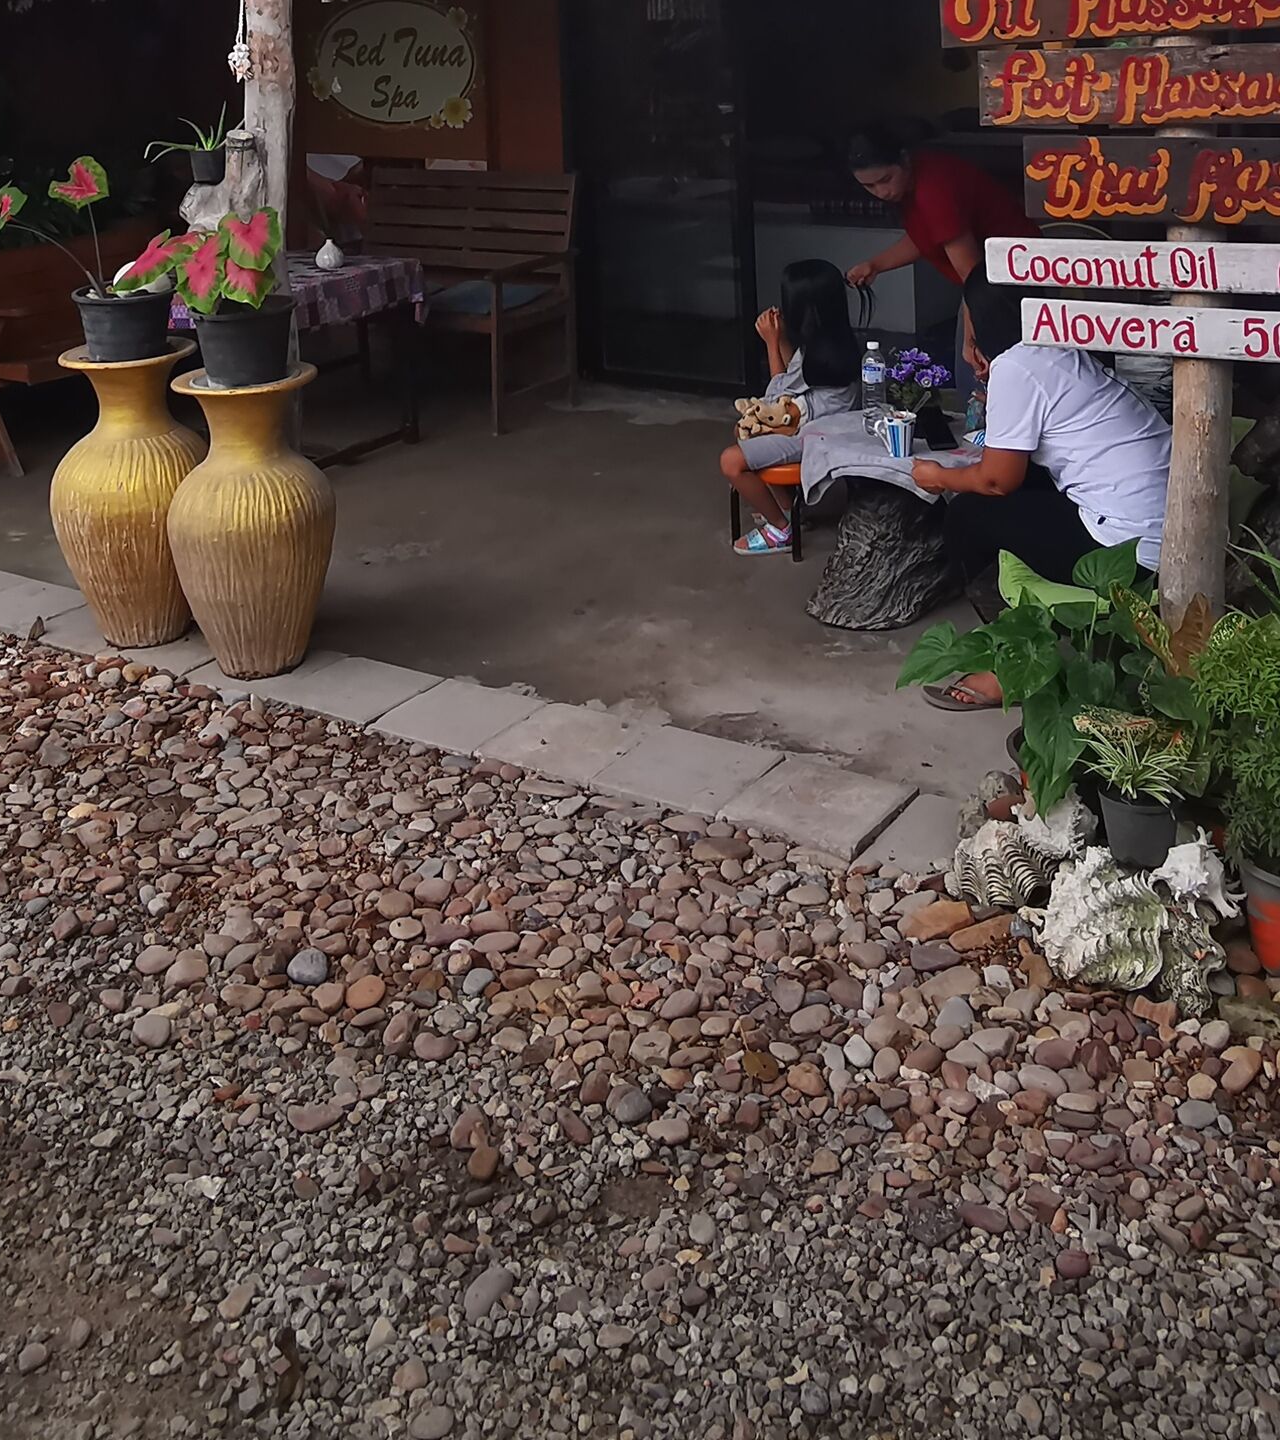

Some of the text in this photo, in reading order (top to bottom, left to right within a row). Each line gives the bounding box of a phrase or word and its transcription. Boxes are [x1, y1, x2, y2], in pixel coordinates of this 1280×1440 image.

[331, 27, 467, 69] Red Tuna
[370, 75, 420, 118] Spa
[1007, 244, 1158, 289] Coconut
[1171, 247, 1220, 291] Oil
[1031, 304, 1198, 354] Alovera
